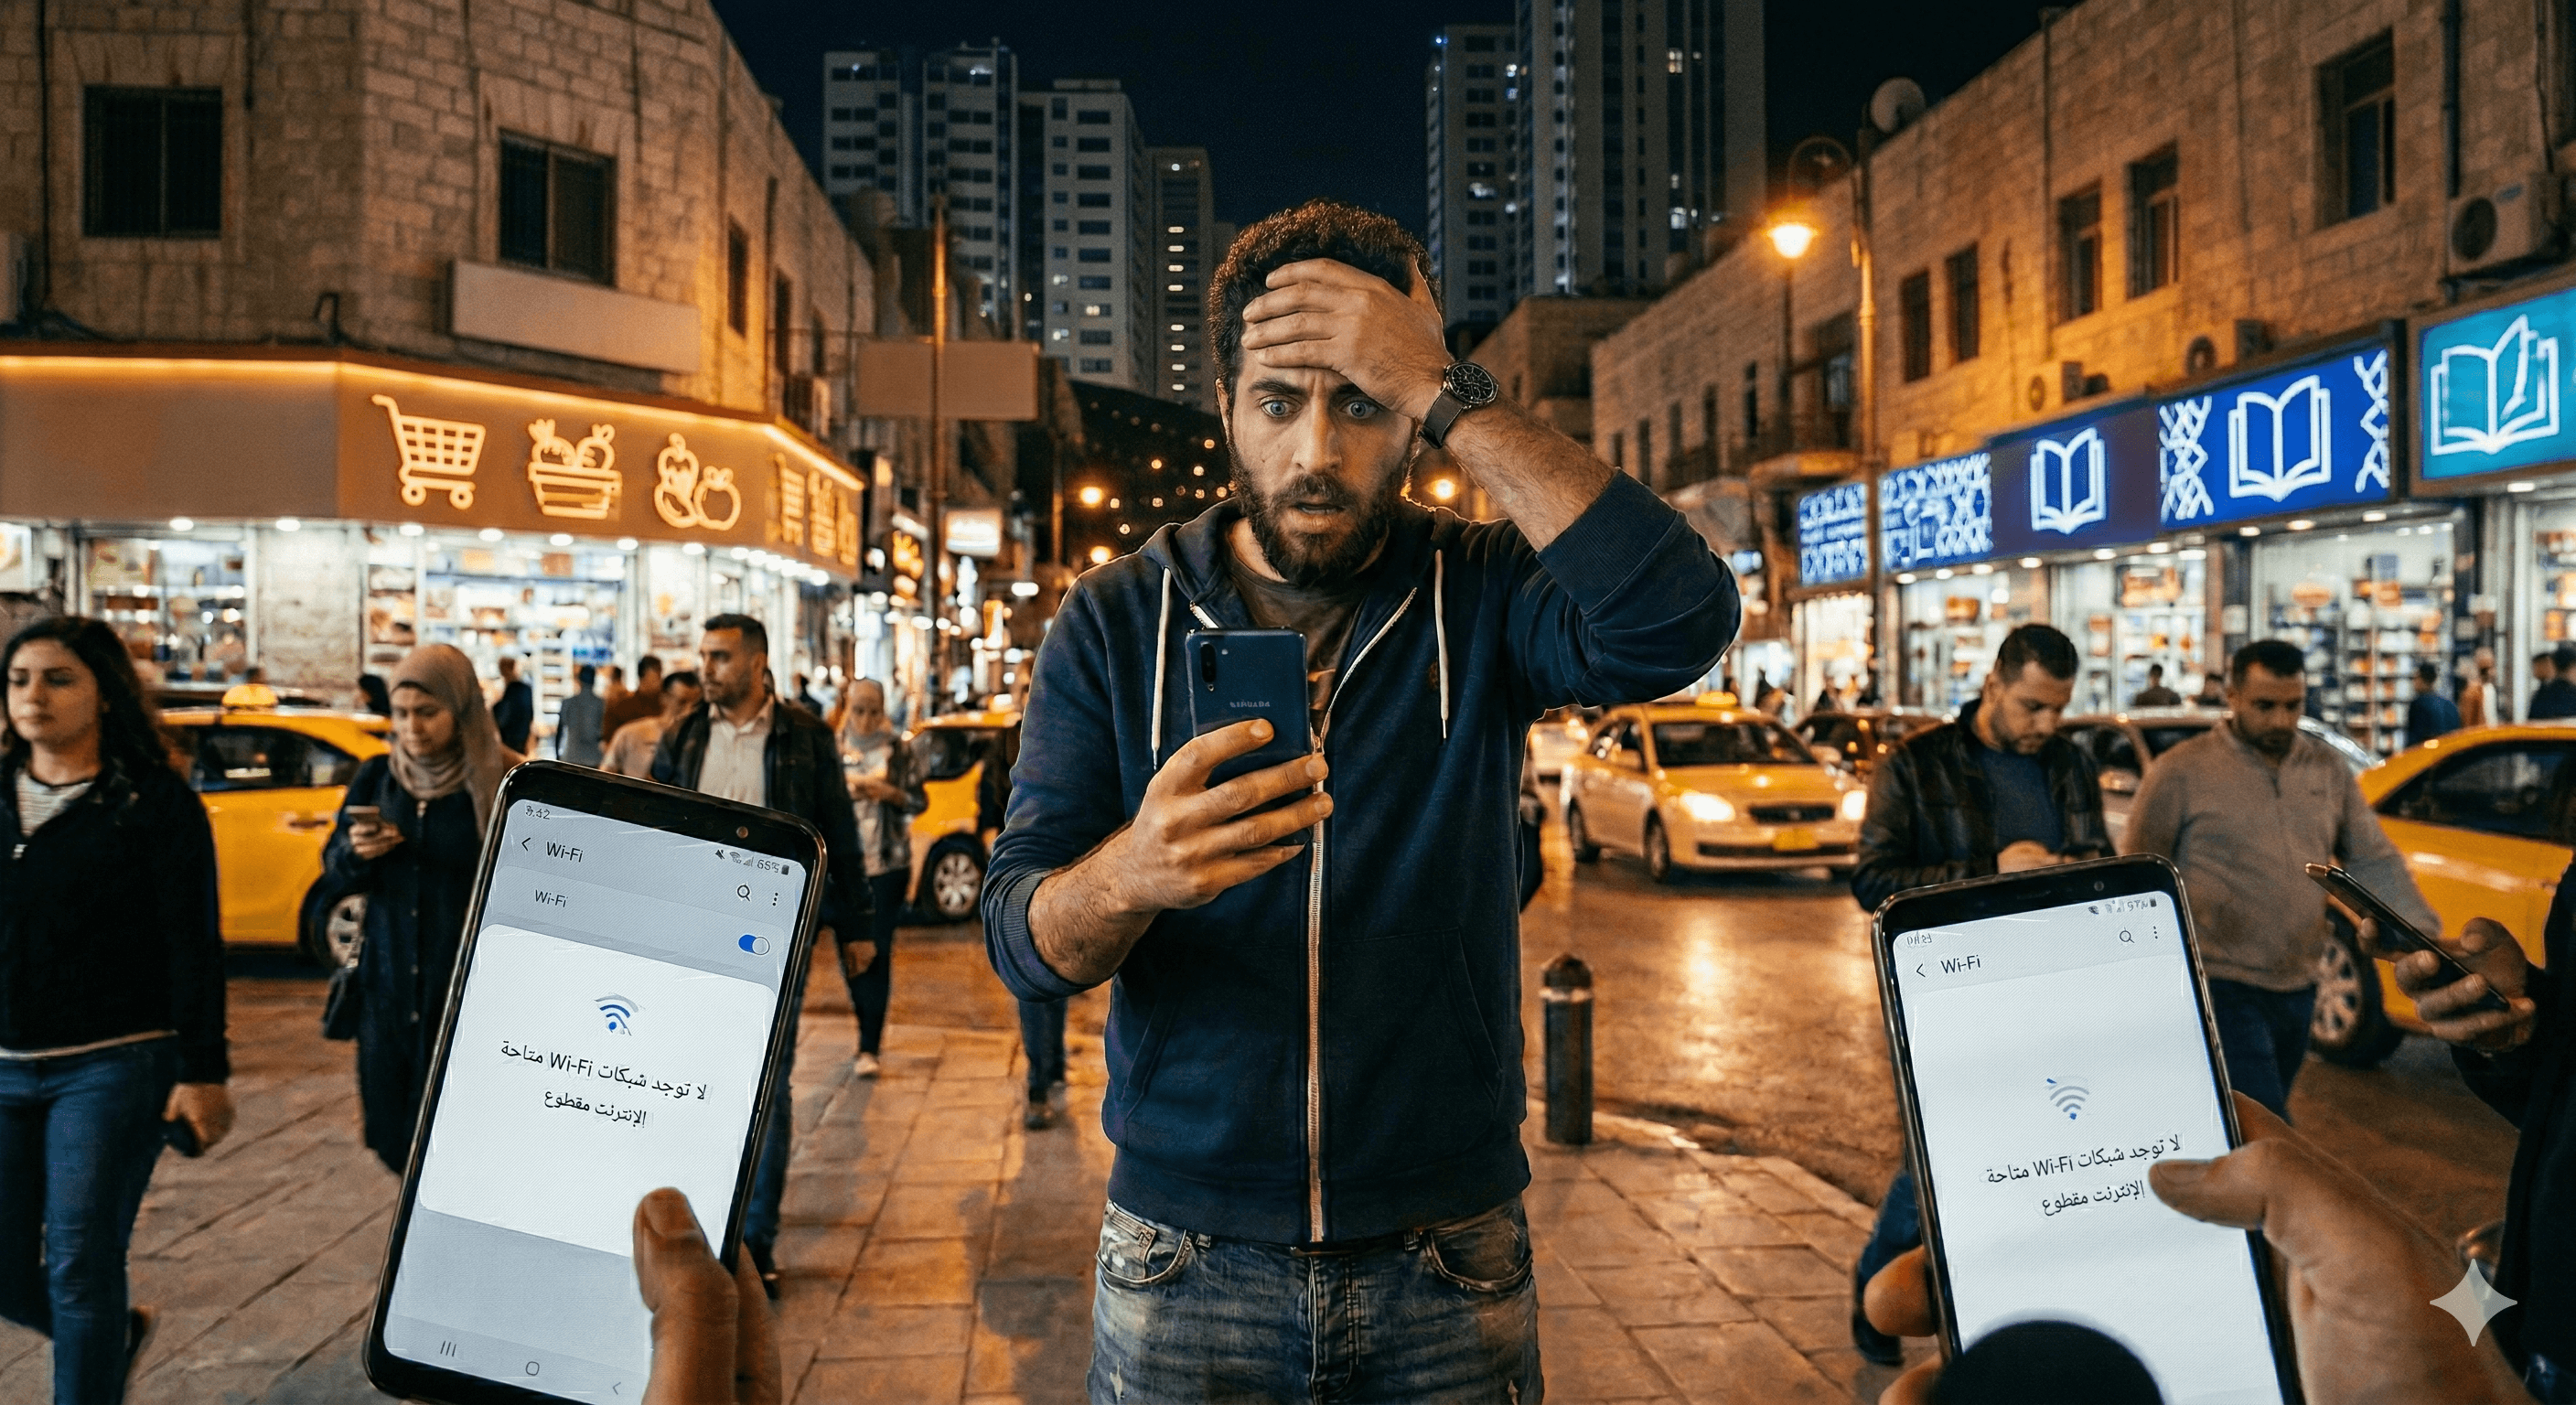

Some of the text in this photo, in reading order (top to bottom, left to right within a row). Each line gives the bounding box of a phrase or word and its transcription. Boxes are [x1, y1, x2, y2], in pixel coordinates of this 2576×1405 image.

[546, 841, 584, 863] Wi-Fi
[534, 889, 569, 908] Wi-Fi
[1940, 954, 1980, 974] Wi-Fi
[500, 1040, 707, 1100] لا توجد شبكات Wi-Fi متاحة
[544, 1090, 590, 1111] مقطوع
[1987, 1133, 2181, 1183] لا توجد شبكات Wi-Fi متاحة
[2042, 1192, 2088, 1217] مقطوع
